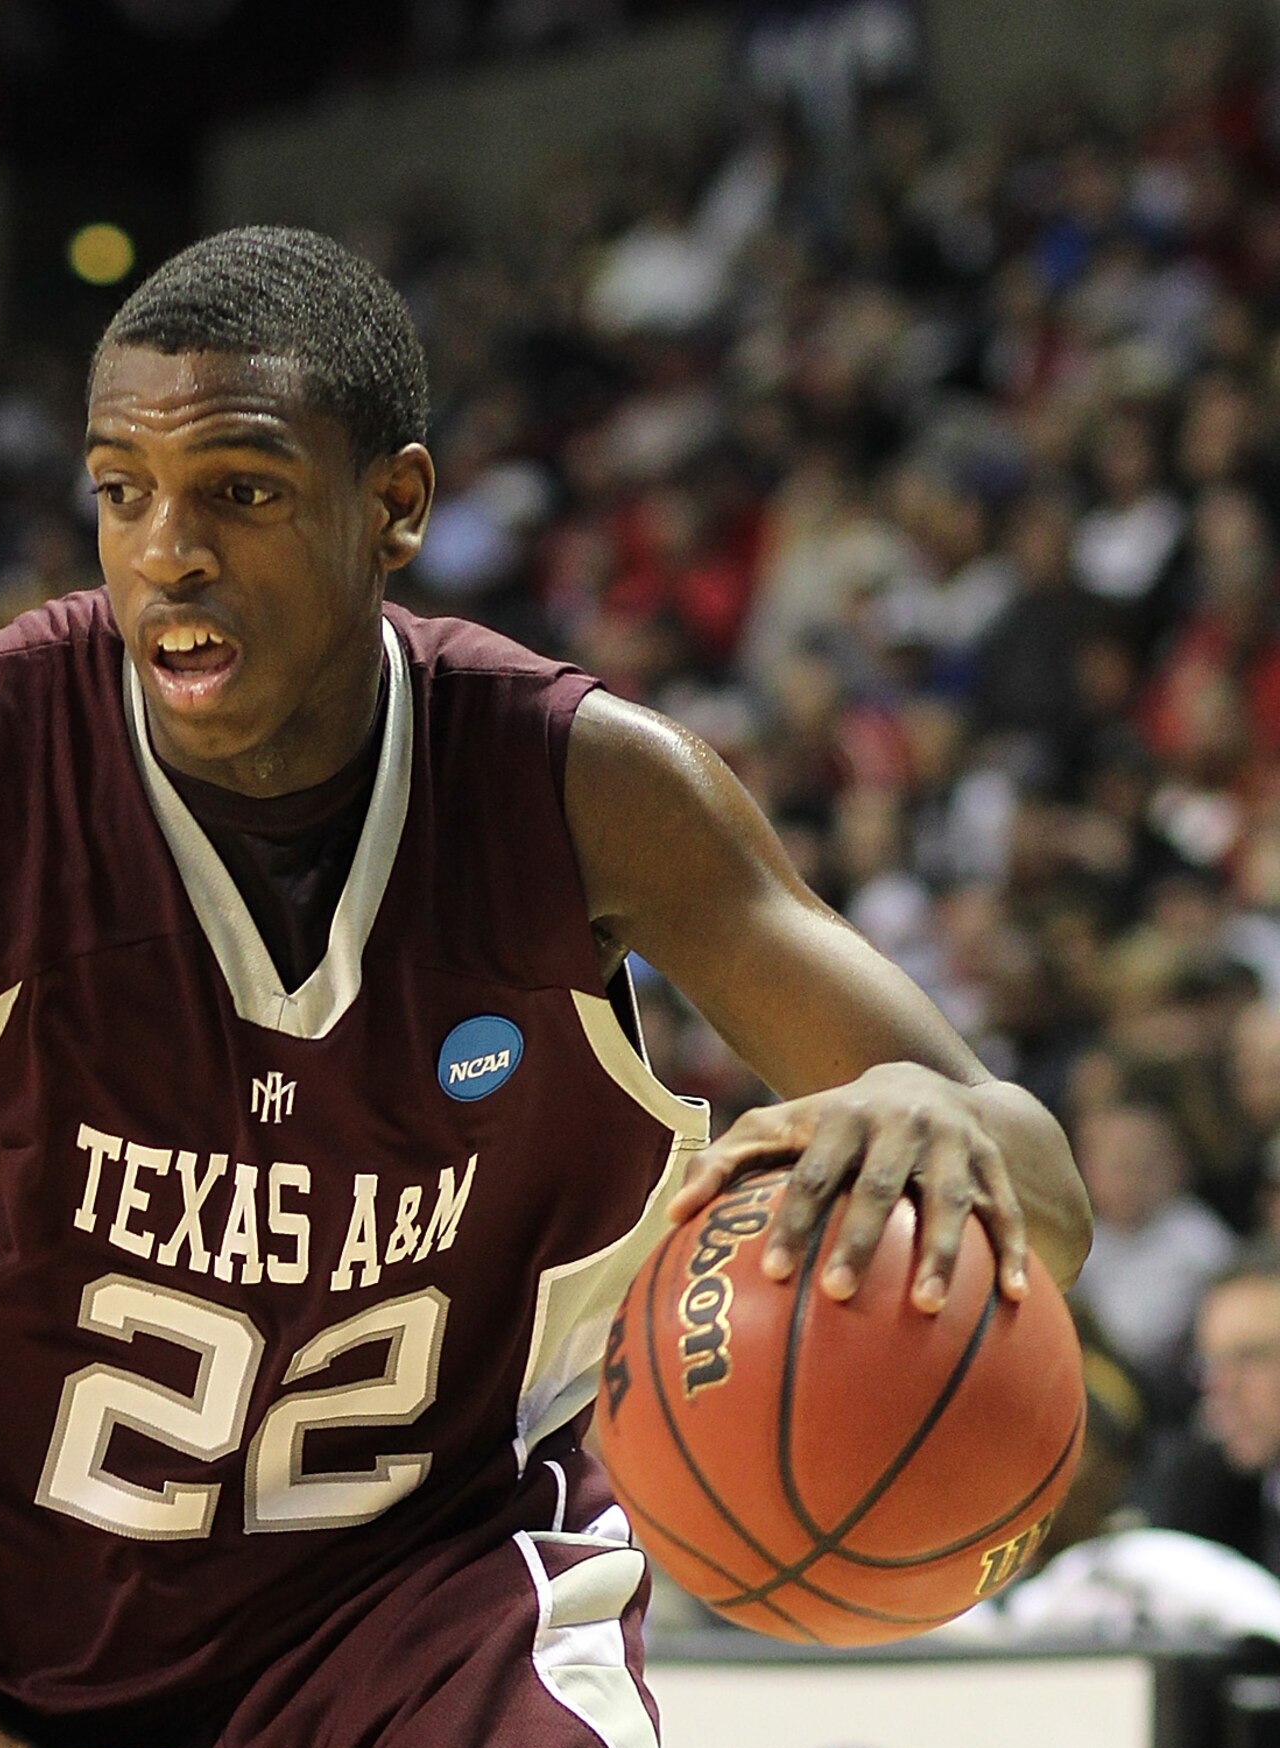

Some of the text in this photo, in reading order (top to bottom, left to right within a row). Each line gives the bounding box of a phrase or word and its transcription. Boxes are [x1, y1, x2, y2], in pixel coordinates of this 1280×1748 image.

[448, 1049, 512, 1084] NCAA
[74, 1123, 478, 1292] TEXAS A&M
[33, 1272, 452, 1540] 22
